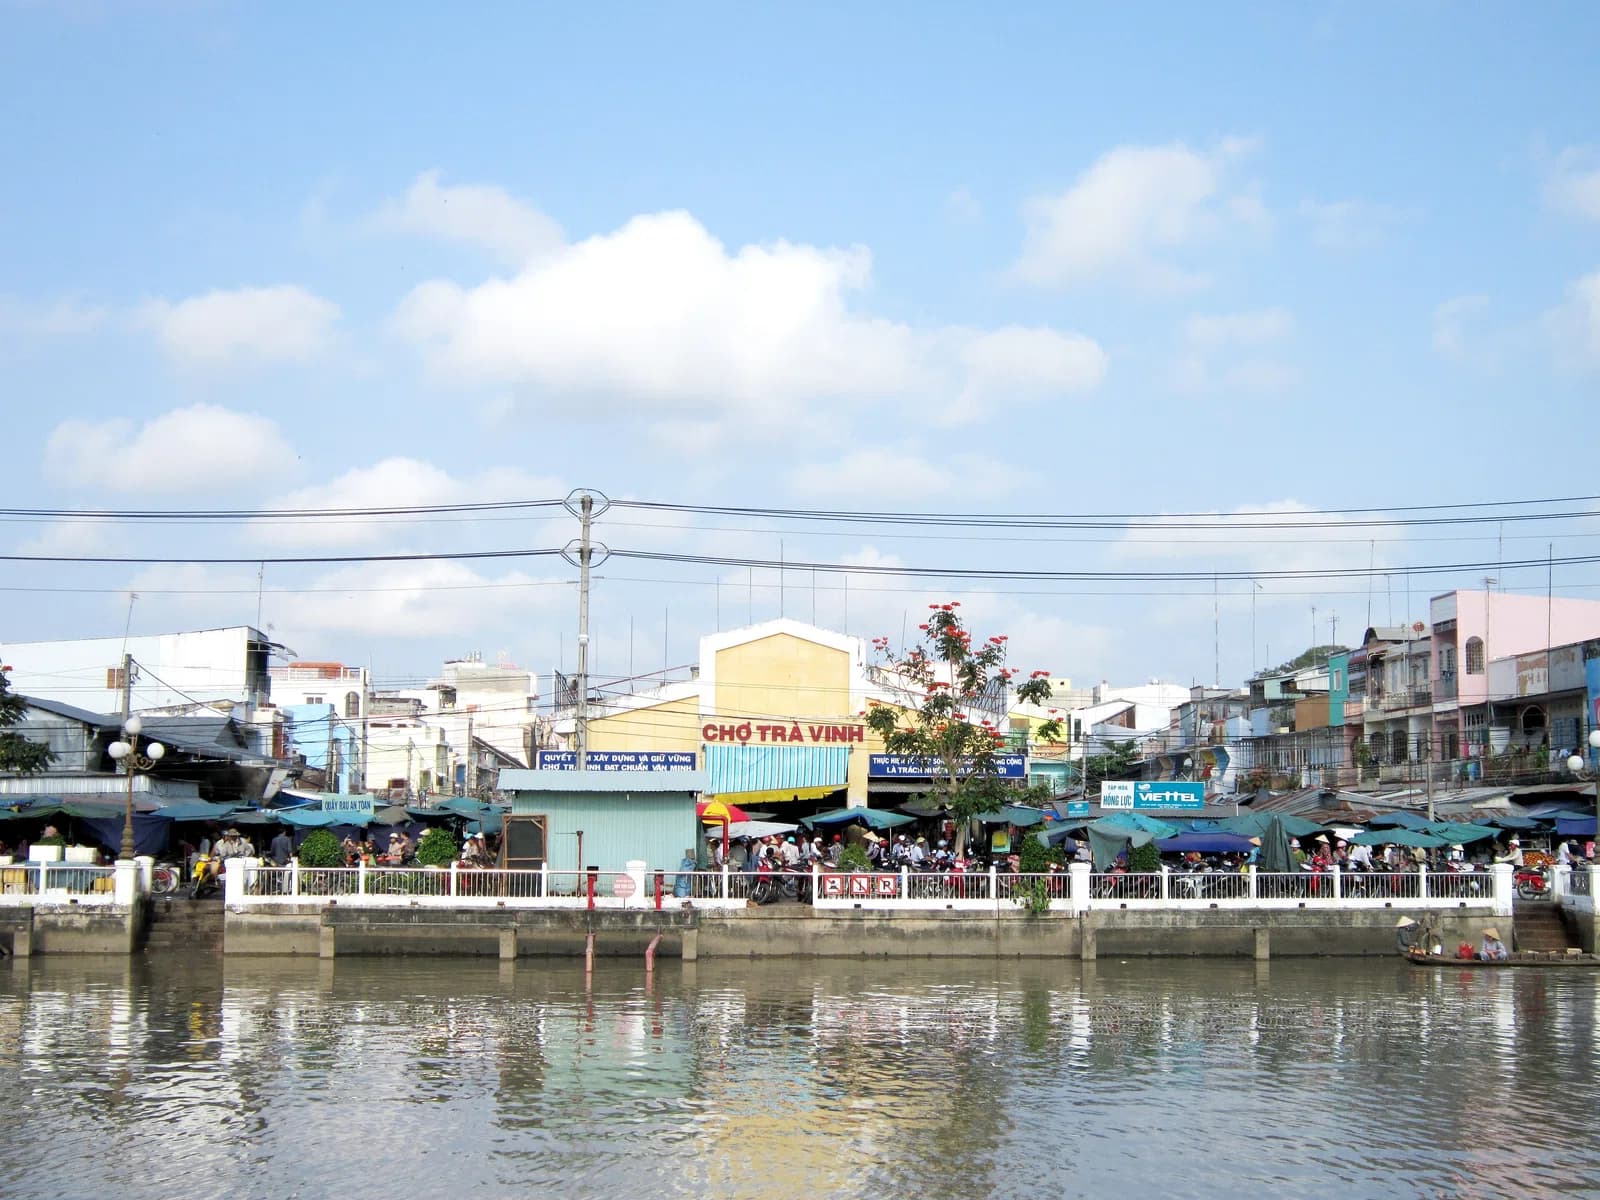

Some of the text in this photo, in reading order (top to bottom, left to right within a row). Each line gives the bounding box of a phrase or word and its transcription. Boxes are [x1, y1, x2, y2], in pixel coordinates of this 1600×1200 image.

[702, 720, 864, 746] CHỢ TRÀ VINH
[544, 752, 573, 763] QUYẾT
[593, 753, 609, 762] XÂY
